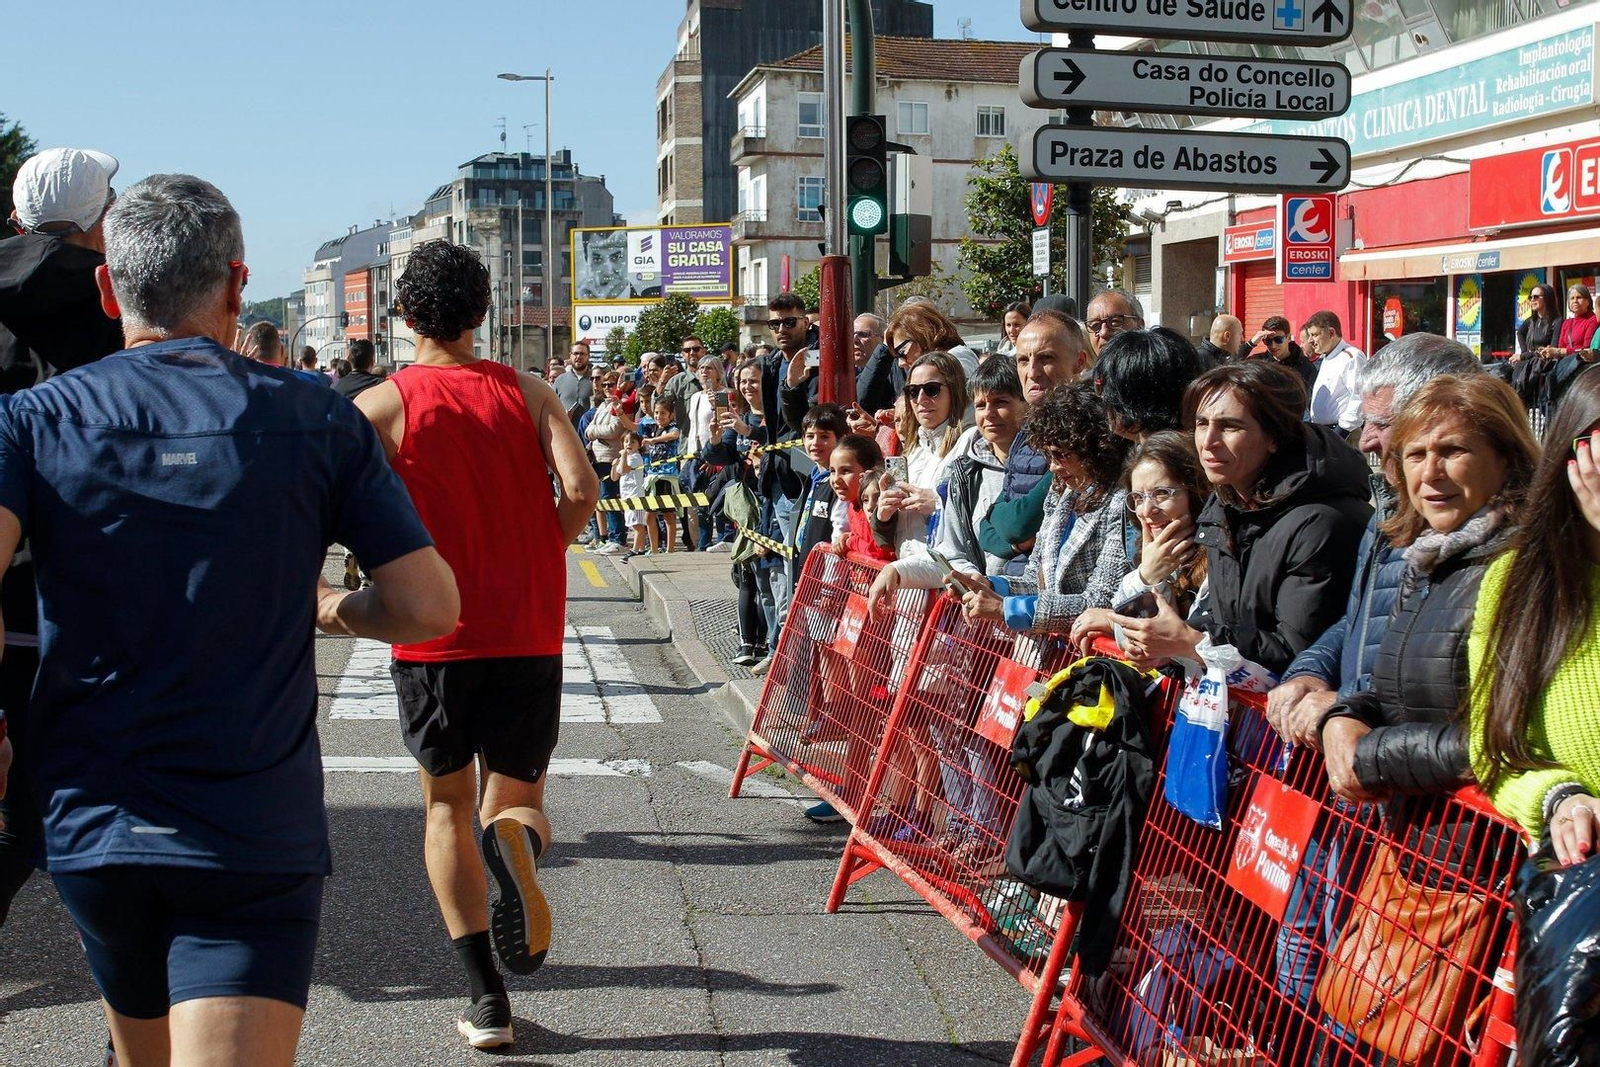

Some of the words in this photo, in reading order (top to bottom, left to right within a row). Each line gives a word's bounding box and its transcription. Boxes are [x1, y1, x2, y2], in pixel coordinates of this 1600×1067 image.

[1147, 0, 1177, 16] de
[1518, 30, 1592, 67] Implantología
[1132, 59, 1190, 81] Casa
[1199, 63, 1228, 83] do
[1236, 64, 1335, 88] Concello
[1495, 61, 1567, 95] Rehabilitación
[1568, 52, 1591, 76] oral
[1189, 86, 1266, 108] Policía
[1276, 90, 1334, 111] Local
[1492, 90, 1544, 117] Radiología
[1551, 79, 1590, 104] Cirugía
[1050, 140, 1124, 168] Praza
[1133, 145, 1165, 170] de
[1173, 146, 1278, 175] Abastos
[1581, 157, 1600, 196] E
[669, 230, 722, 240] VALORAMOS
[1234, 234, 1255, 249] EROSKI
[1256, 233, 1273, 247] center
[667, 242, 685, 253] SU
[688, 241, 724, 253] CASA
[1289, 250, 1328, 259] EROSKI
[634, 256, 655, 265] GIA
[668, 253, 724, 267] GRATIS.
[1450, 256, 1474, 270] EROSKI
[1477, 256, 1497, 268] center
[1291, 265, 1326, 275] center
[594, 315, 637, 324] INDUPOR
[162, 453, 198, 466] MARVEL
[1255, 850, 1291, 893] Porriño
